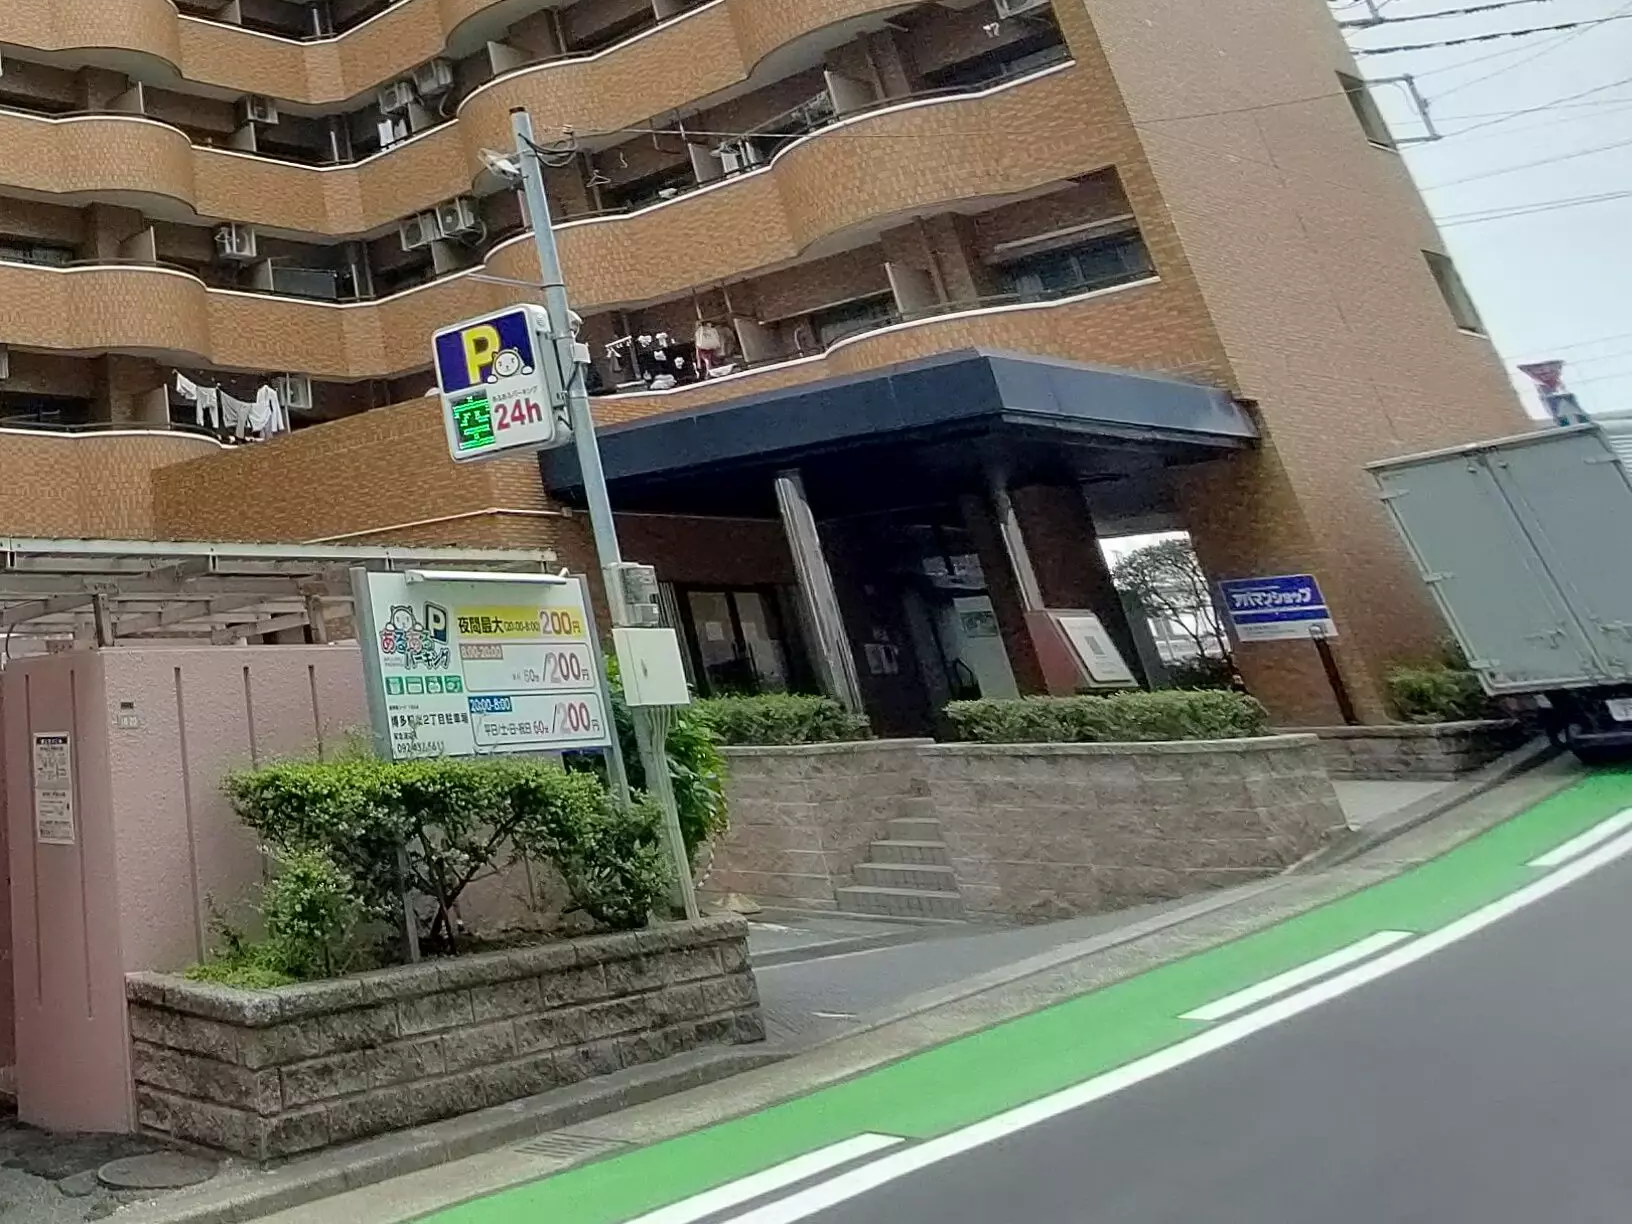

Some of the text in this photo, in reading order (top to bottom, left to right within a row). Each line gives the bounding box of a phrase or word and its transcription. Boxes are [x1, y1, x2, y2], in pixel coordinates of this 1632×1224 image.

[462, 324, 500, 384] P
[452, 396, 496, 450] 空
[494, 397, 542, 430] 24h
[470, 697, 511, 712] 20:00-8:00
